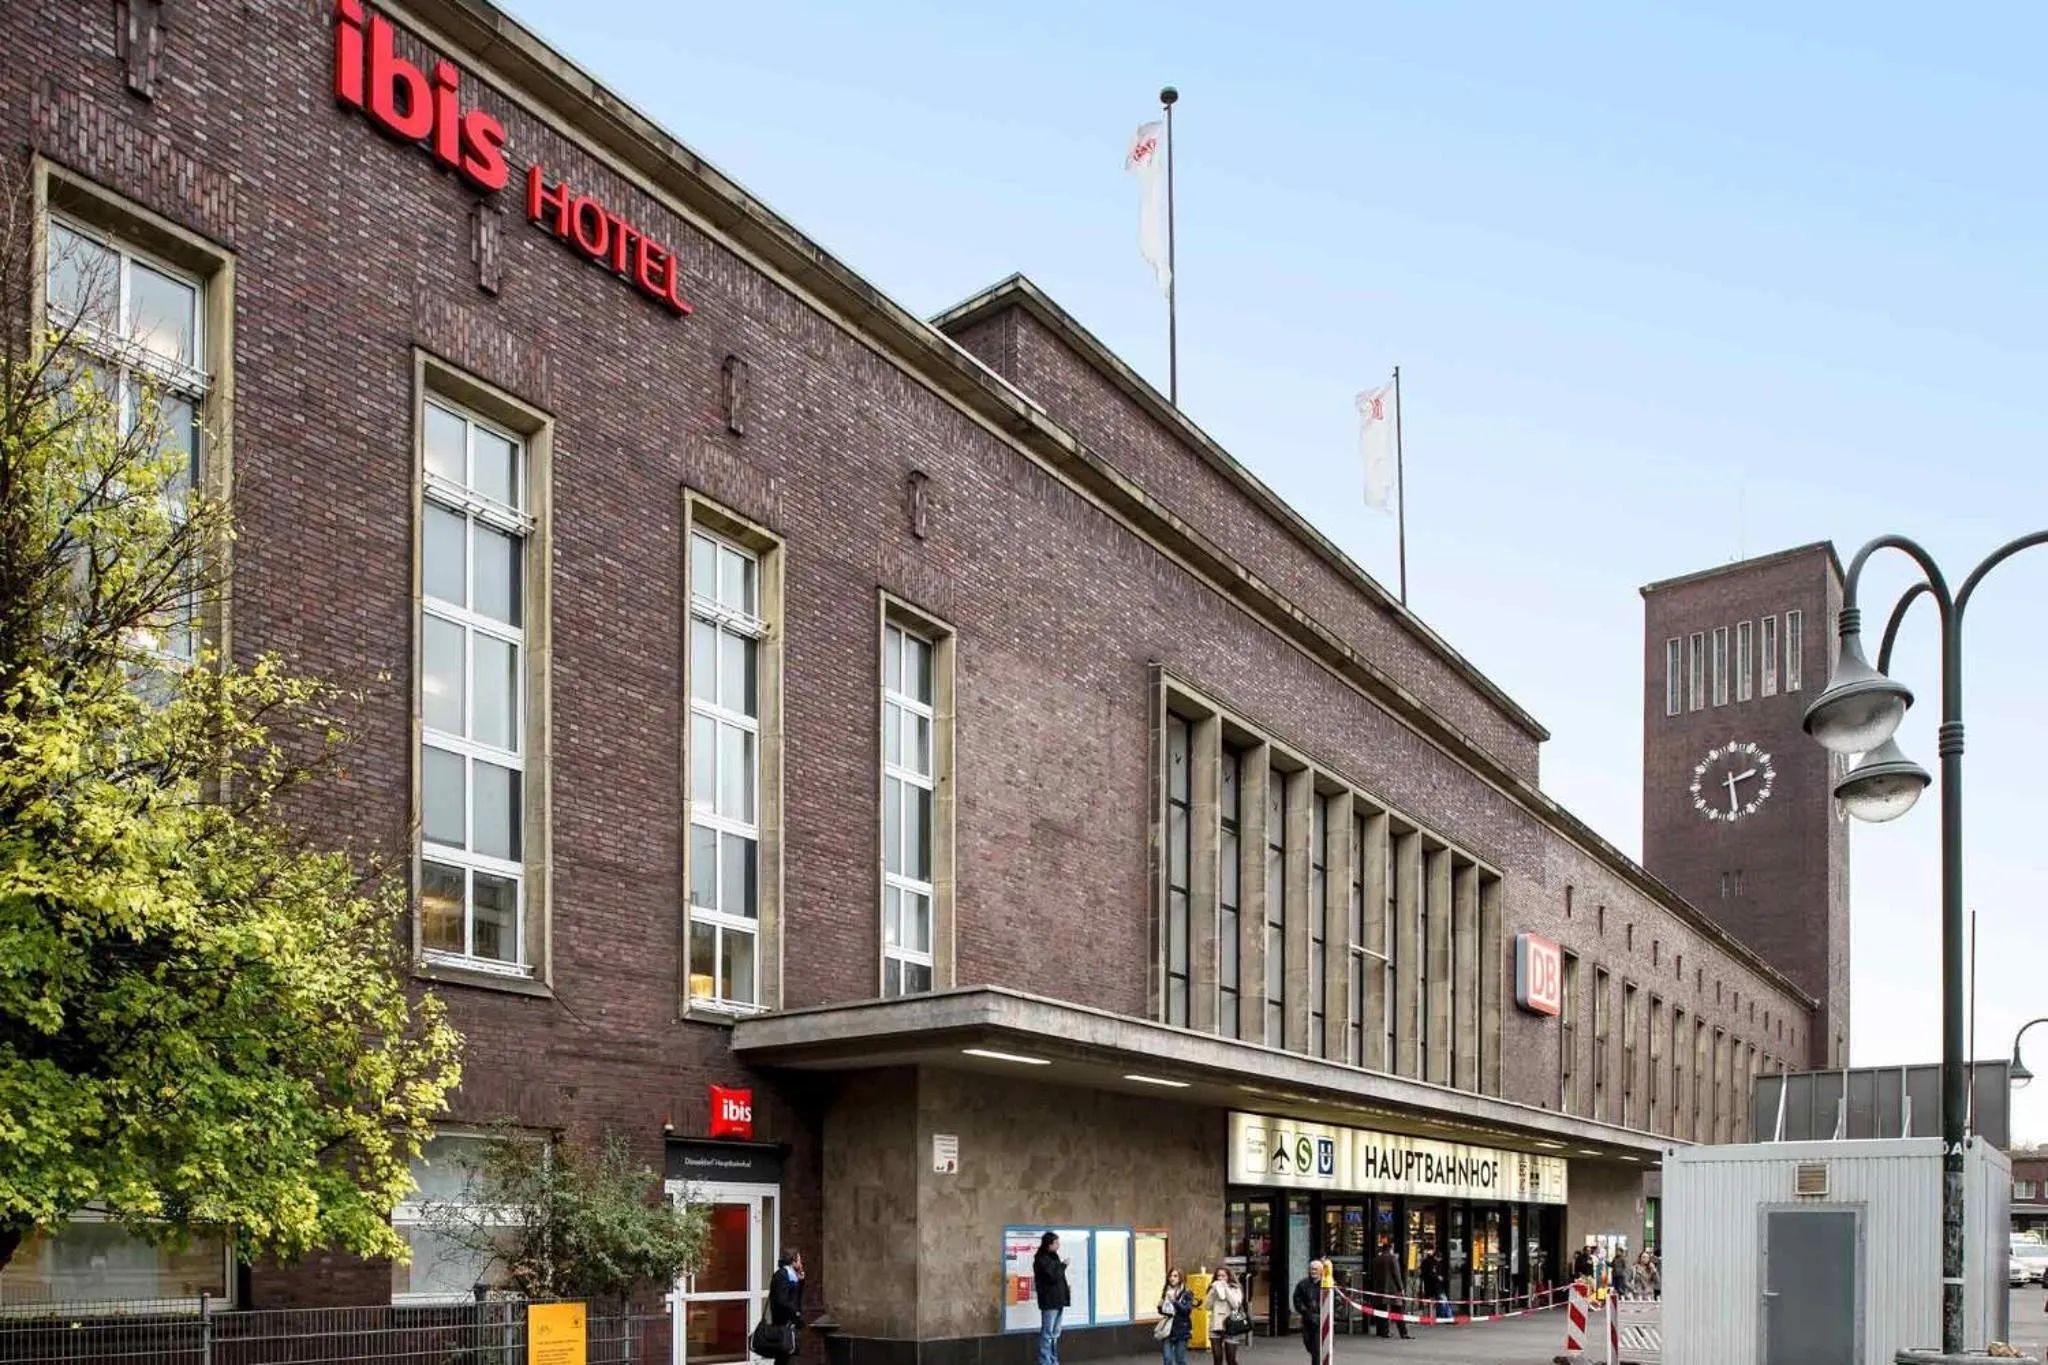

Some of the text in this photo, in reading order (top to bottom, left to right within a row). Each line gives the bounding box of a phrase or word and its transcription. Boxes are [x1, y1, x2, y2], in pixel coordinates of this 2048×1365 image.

[335, 0, 510, 192] ibis
[527, 164, 694, 316] HOTEL
[1532, 947, 1557, 1001] DB
[721, 1098, 752, 1123] ibis
[1298, 1139, 1310, 1170] S
[1320, 1143, 1331, 1171] U
[1365, 1144, 1499, 1189] HAUPTBAHNHOF
